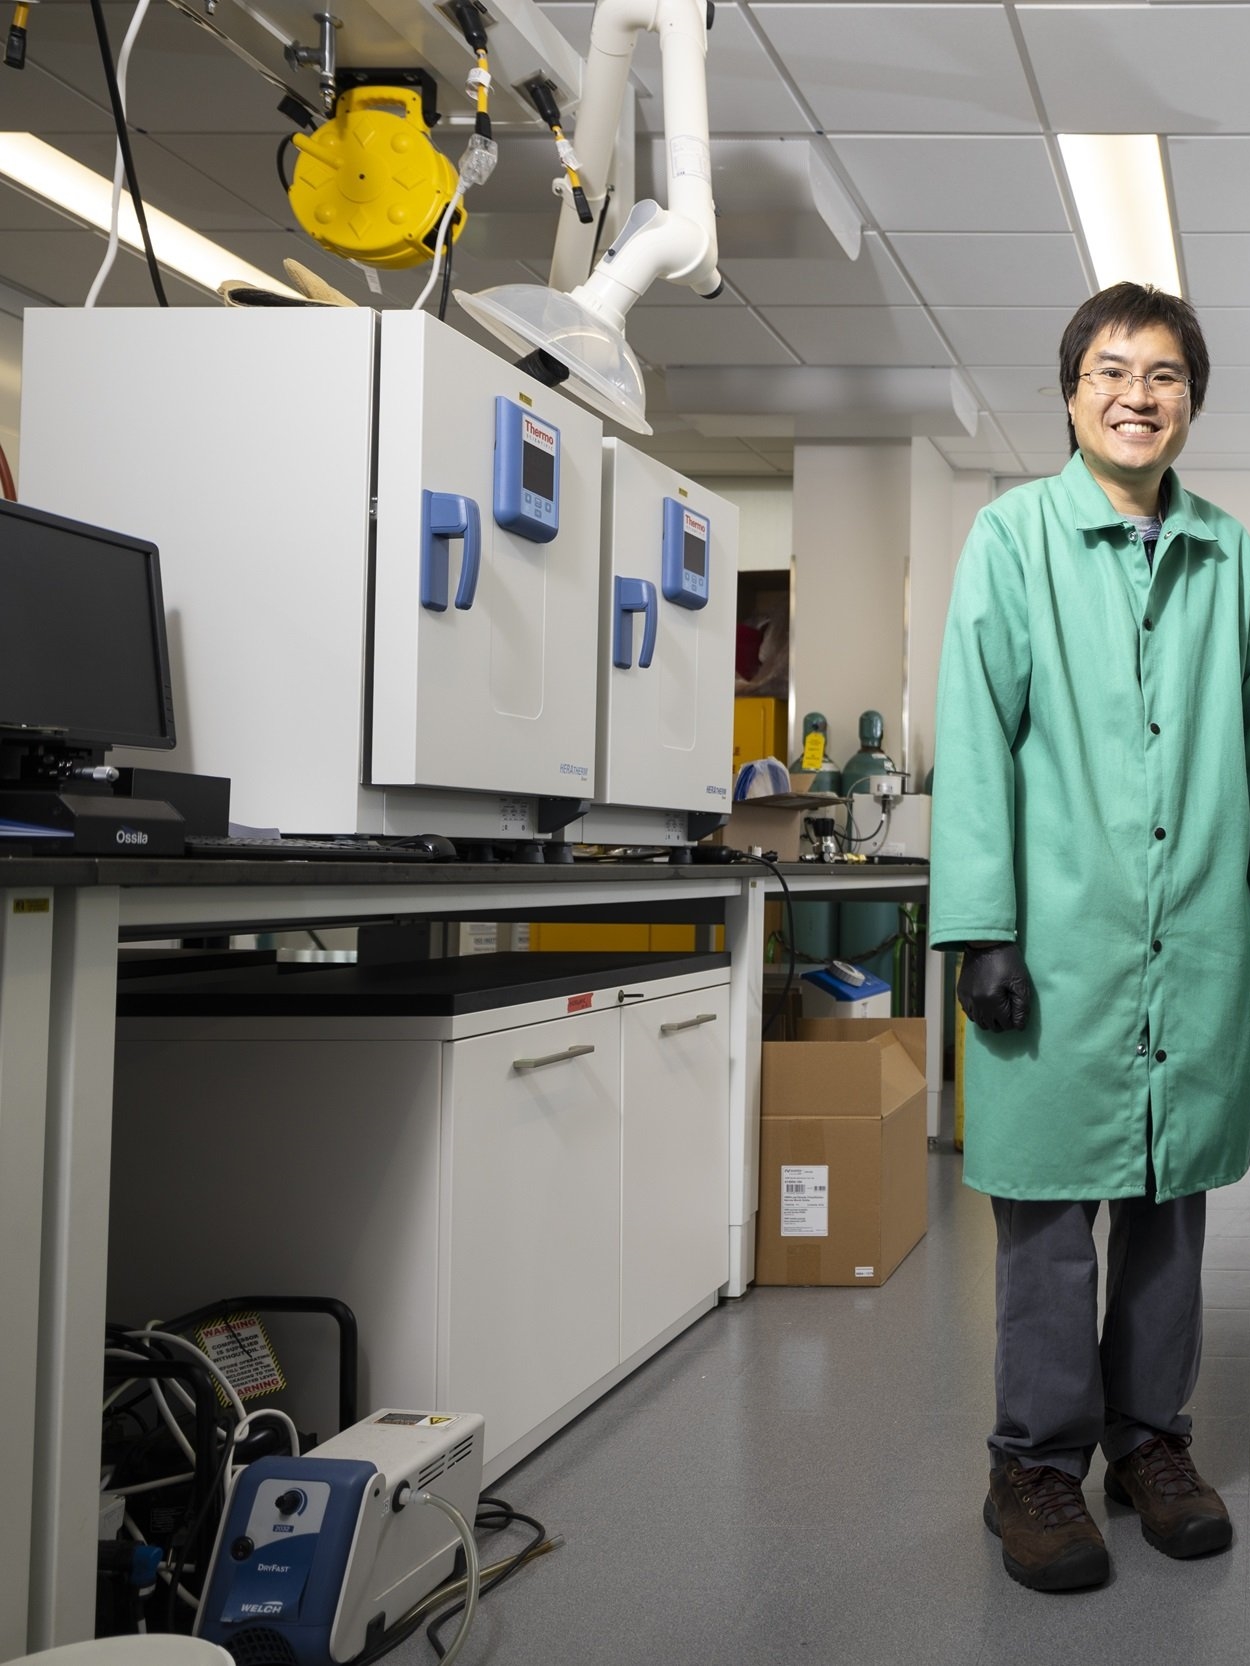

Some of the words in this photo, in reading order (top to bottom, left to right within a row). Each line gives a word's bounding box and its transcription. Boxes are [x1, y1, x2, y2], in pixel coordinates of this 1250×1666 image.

[525, 419, 554, 445] Thermo
[685, 514, 705, 533] Thermo
[559, 763, 589, 776] HERATHERM
[706, 785, 727, 795] HERATHERM
[116, 829, 148, 844] Ossila
[203, 1319, 257, 1338] WARNING
[212, 1351, 245, 1363] WITHOUT
[219, 1362, 238, 1371] EFORE
[226, 1369, 252, 1379] NCLOSED
[237, 1378, 280, 1396] ARNING
[240, 1603, 282, 1614] WELCH
